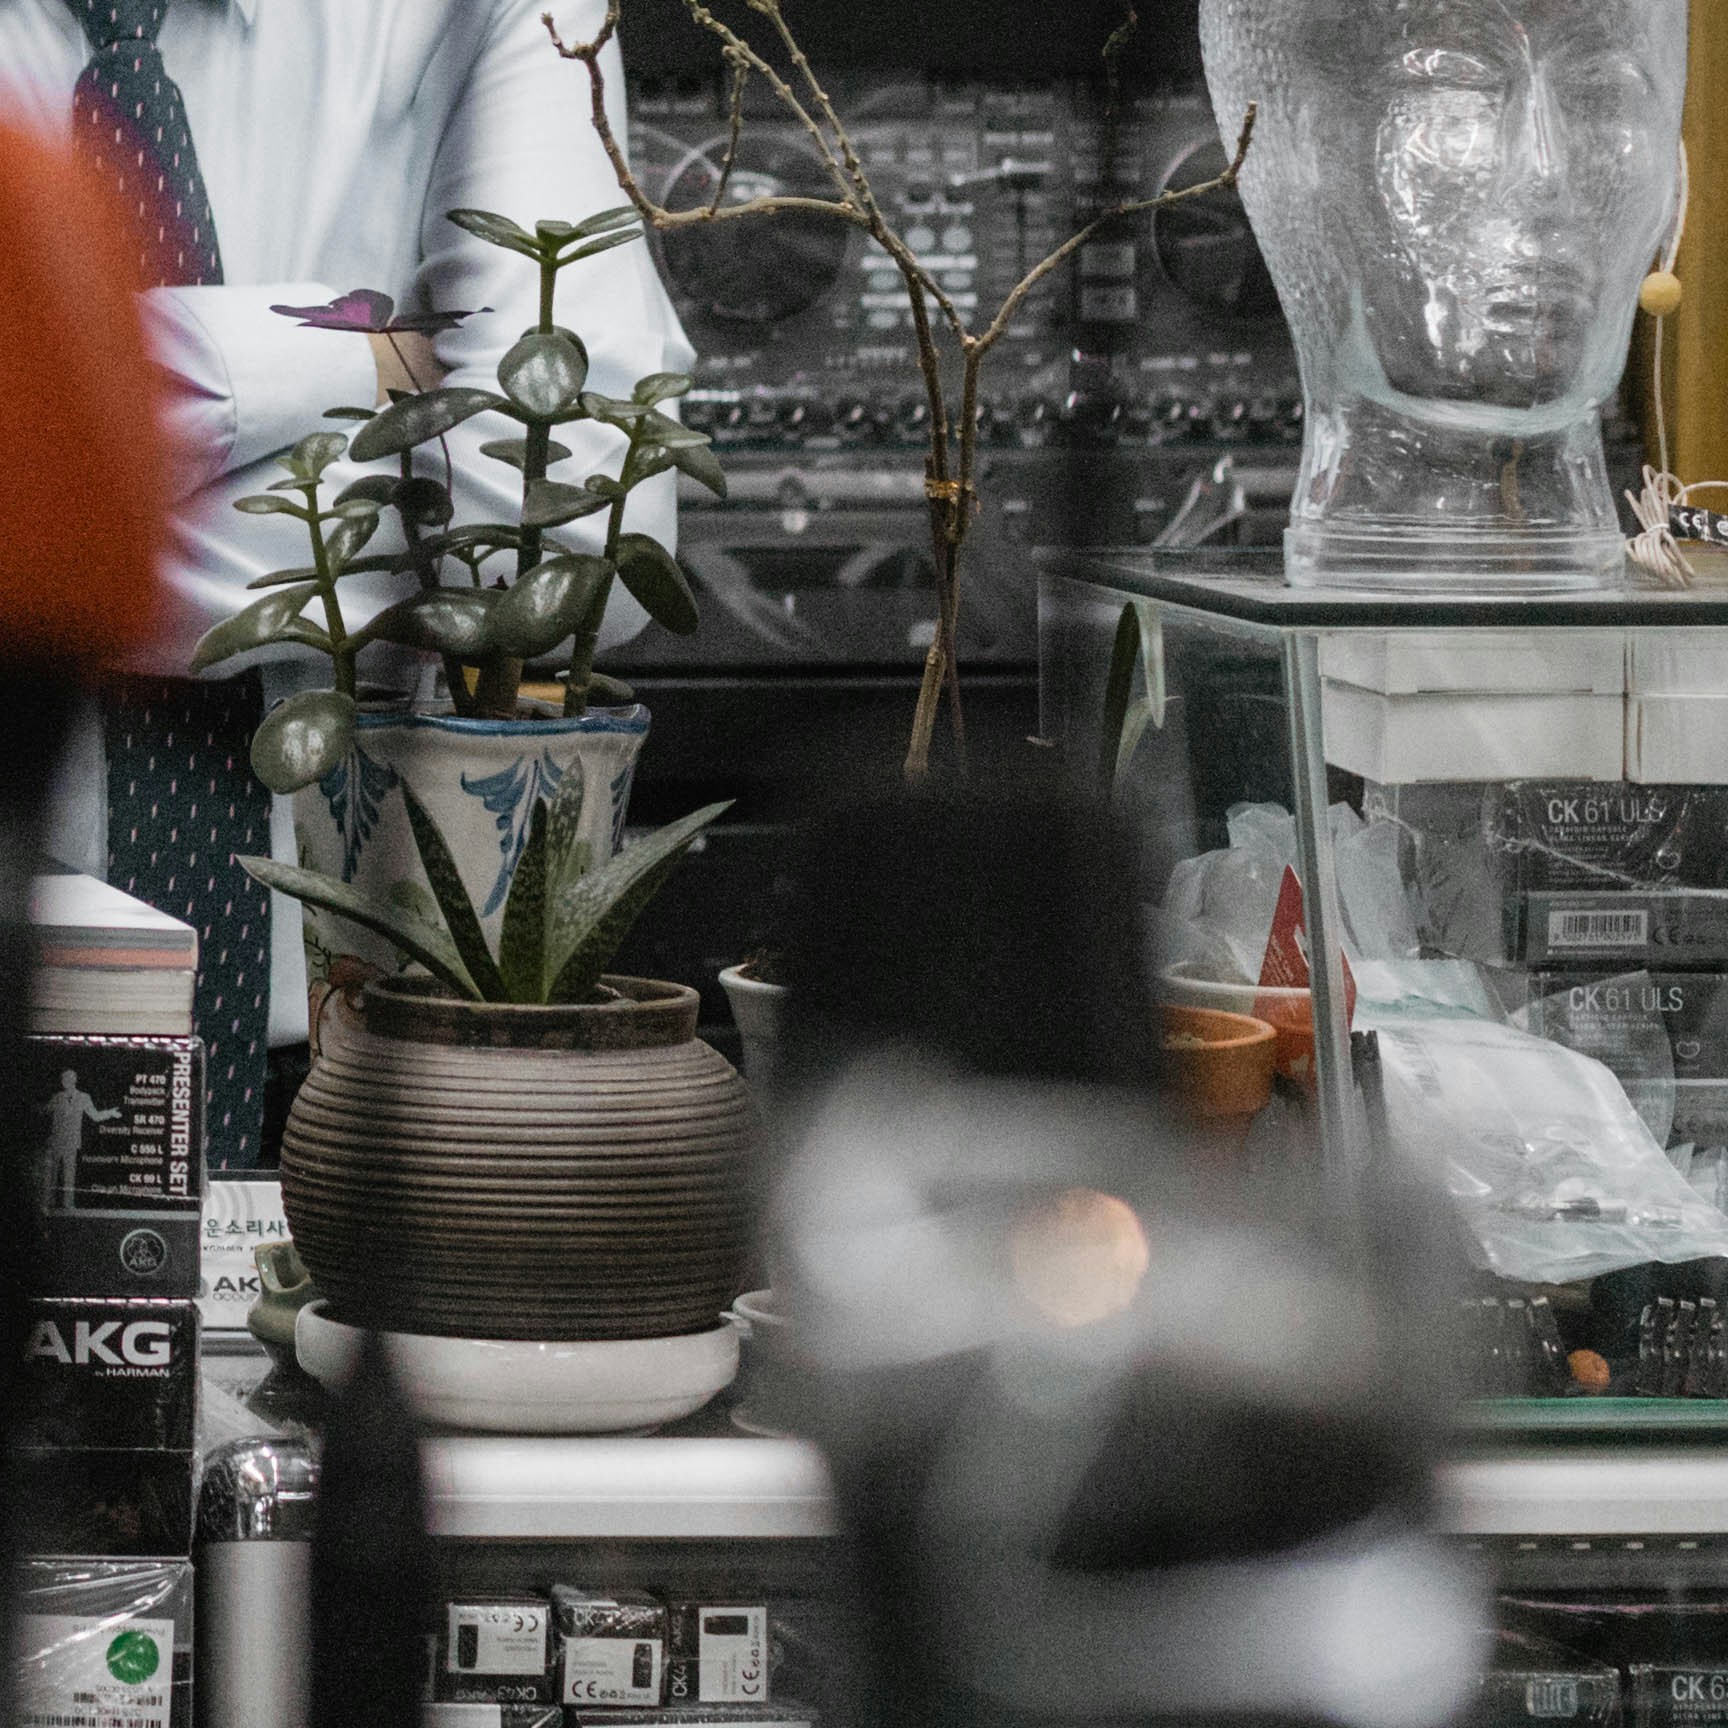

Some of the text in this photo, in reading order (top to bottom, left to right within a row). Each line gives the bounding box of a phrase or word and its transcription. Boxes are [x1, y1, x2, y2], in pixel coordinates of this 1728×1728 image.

[1548, 798, 1667, 823] CK 61 ULS
[1569, 986, 1684, 1012] CK 61 ULS
[135, 1073, 166, 1085] PT 470
[133, 1114, 165, 1125] SR 470
[168, 1050, 193, 1196] PRESENTER SET
[129, 1173, 142, 1184] CK
[212, 1275, 260, 1293] AK
[30, 1321, 172, 1366] AKG
[105, 1368, 170, 1377] HARMAN
[1671, 1674, 1705, 1701] CK
